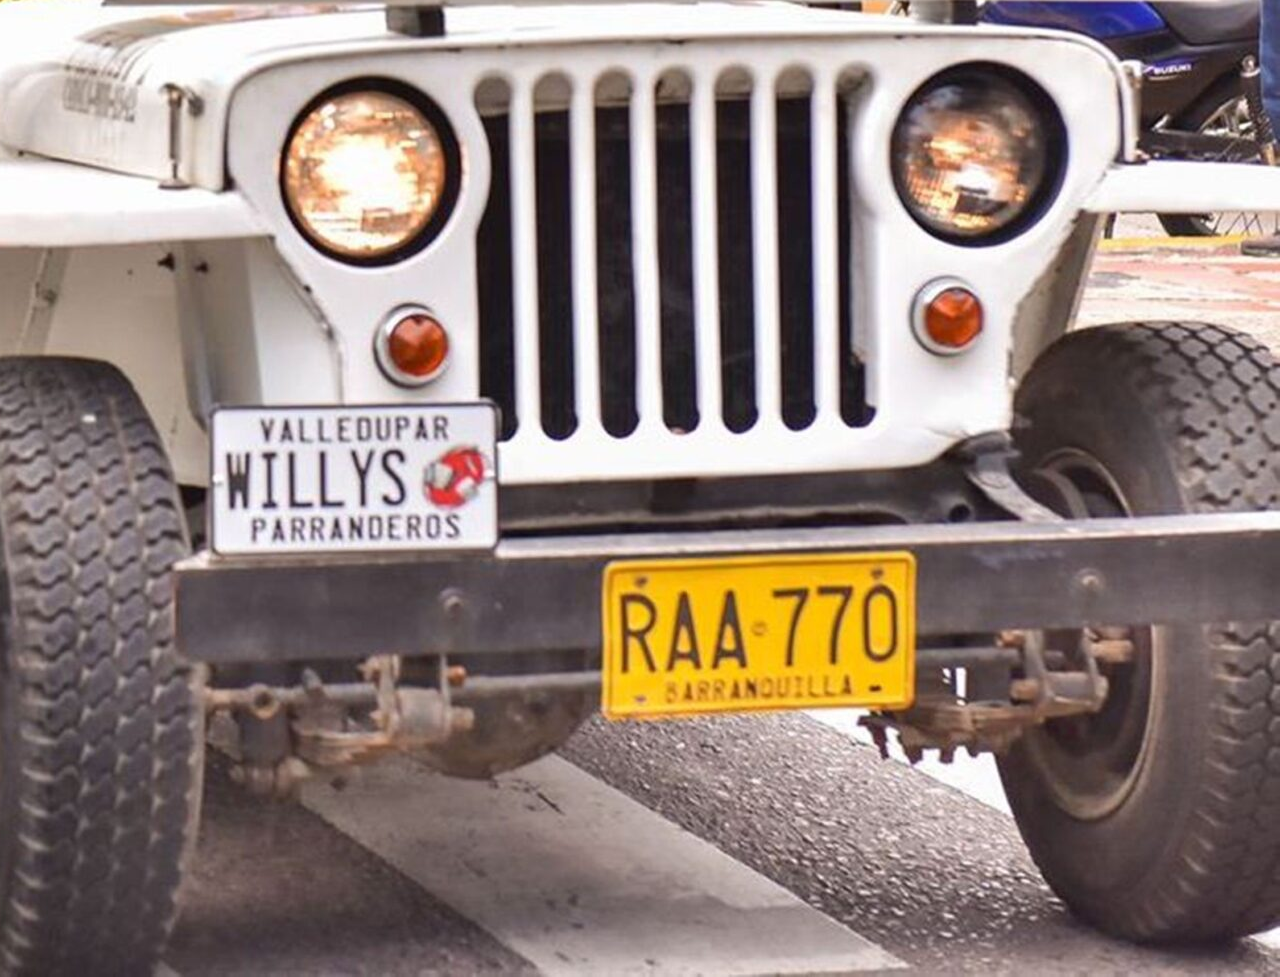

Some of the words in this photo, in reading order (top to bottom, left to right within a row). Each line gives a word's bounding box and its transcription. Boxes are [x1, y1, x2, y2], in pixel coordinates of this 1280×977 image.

[260, 415, 450, 444] VALLEDUPAR
[226, 448, 407, 510] WILLYS
[250, 513, 462, 543] PARRANDEROS
[620, 589, 748, 674] RAA
[772, 583, 899, 668] 770
[664, 674, 854, 704] BARRANQUILLA
